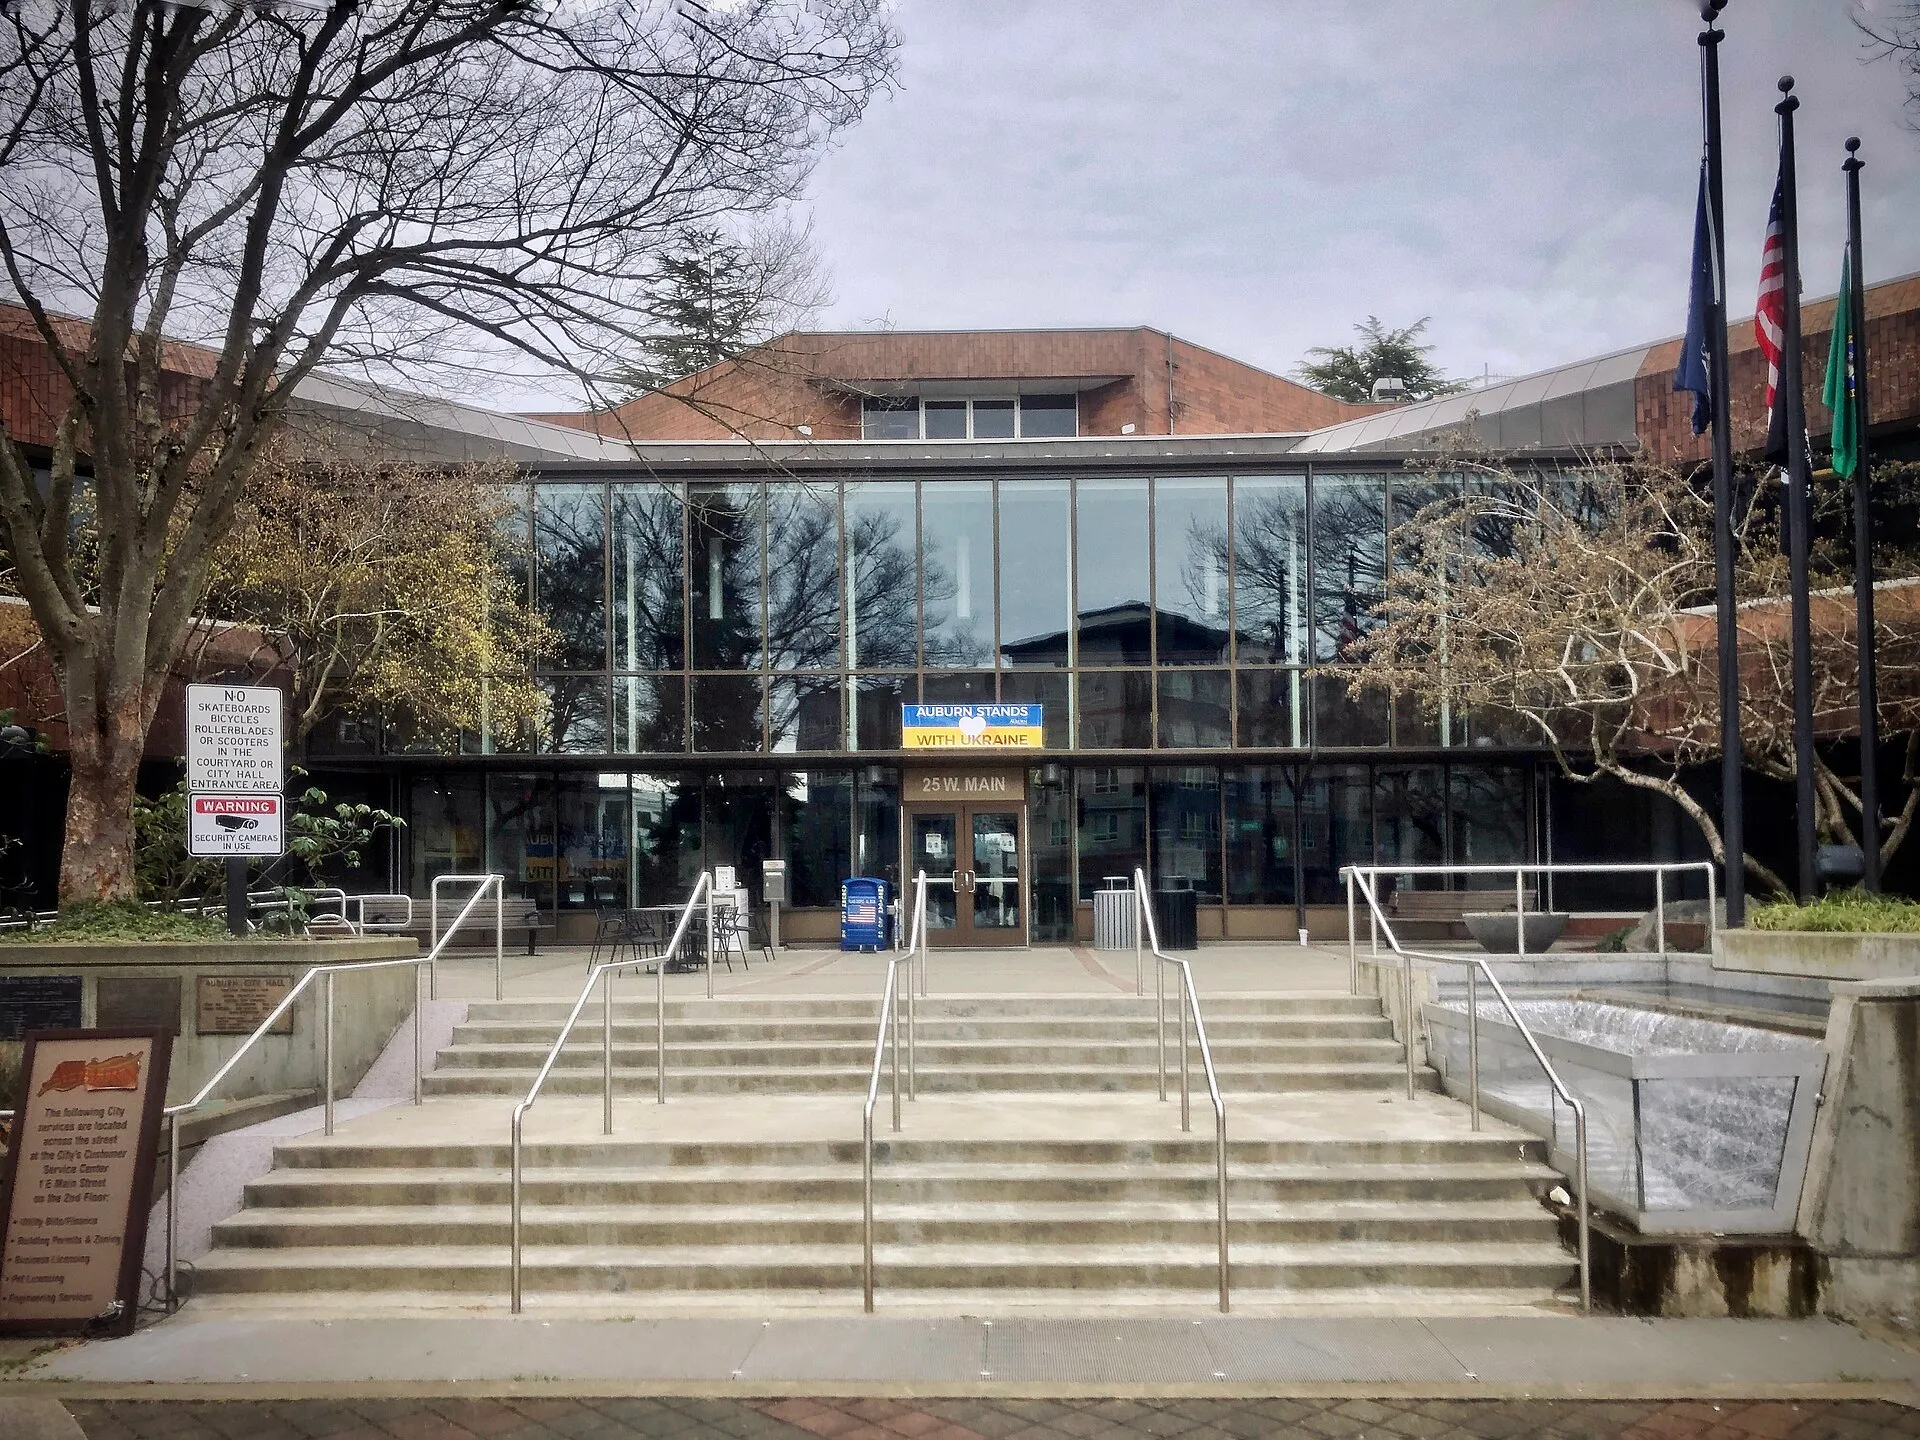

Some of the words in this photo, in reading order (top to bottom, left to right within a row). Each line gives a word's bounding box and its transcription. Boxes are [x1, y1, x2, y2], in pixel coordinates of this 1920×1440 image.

[224, 690, 246, 702] NO
[198, 703, 271, 714] SKATEBOARDS
[916, 706, 972, 717] AUBURN
[976, 706, 1028, 717] STANDS
[210, 714, 259, 724] BICYCLES
[194, 725, 274, 735] ROLLERBLADES
[200, 736, 213, 745] OR
[218, 737, 269, 747] SCOOTERS
[916, 734, 955, 746] WITH
[961, 734, 1028, 746] UKRAINE
[217, 747, 227, 756] IN
[233, 748, 252, 757] THE
[196, 758, 256, 768] COURTYARD
[260, 760, 273, 769] OR
[207, 769, 230, 778] CITY
[237, 770, 264, 779] HALL
[191, 780, 248, 789] ENTRANCE
[252, 781, 280, 789] AREA
[922, 777, 941, 792] 25
[943, 777, 960, 792] W.
[965, 776, 1006, 792] MAIN
[203, 801, 270, 812] WARNING
[194, 834, 236, 842] SECURITY
[238, 834, 278, 842] CAMERAS
[223, 842, 231, 850] IN
[234, 842, 250, 850] USE
[265, 979, 286, 987] HALL
[45, 1107, 61, 1117] The
[63, 1107, 105, 1118] following
[107, 1106, 125, 1118] City
[38, 1123, 75, 1132] services
[77, 1122, 92, 1131] are
[94, 1120, 128, 1130] located
[43, 1137, 72, 1146] across
[75, 1135, 90, 1145] the
[91, 1135, 118, 1144] street
[29, 1151, 39, 1160] at
[41, 1150, 55, 1160] the
[57, 1150, 81, 1161] City's
[84, 1149, 127, 1159] Customer
[43, 1163, 77, 1174] Service
[79, 1163, 109, 1174] Center
[45, 1179, 52, 1189] E
[54, 1179, 77, 1188] Main
[79, 1178, 106, 1188] Street
[33, 1195, 45, 1203] on
[47, 1193, 61, 1203] the
[63, 1192, 81, 1202] 2nd
